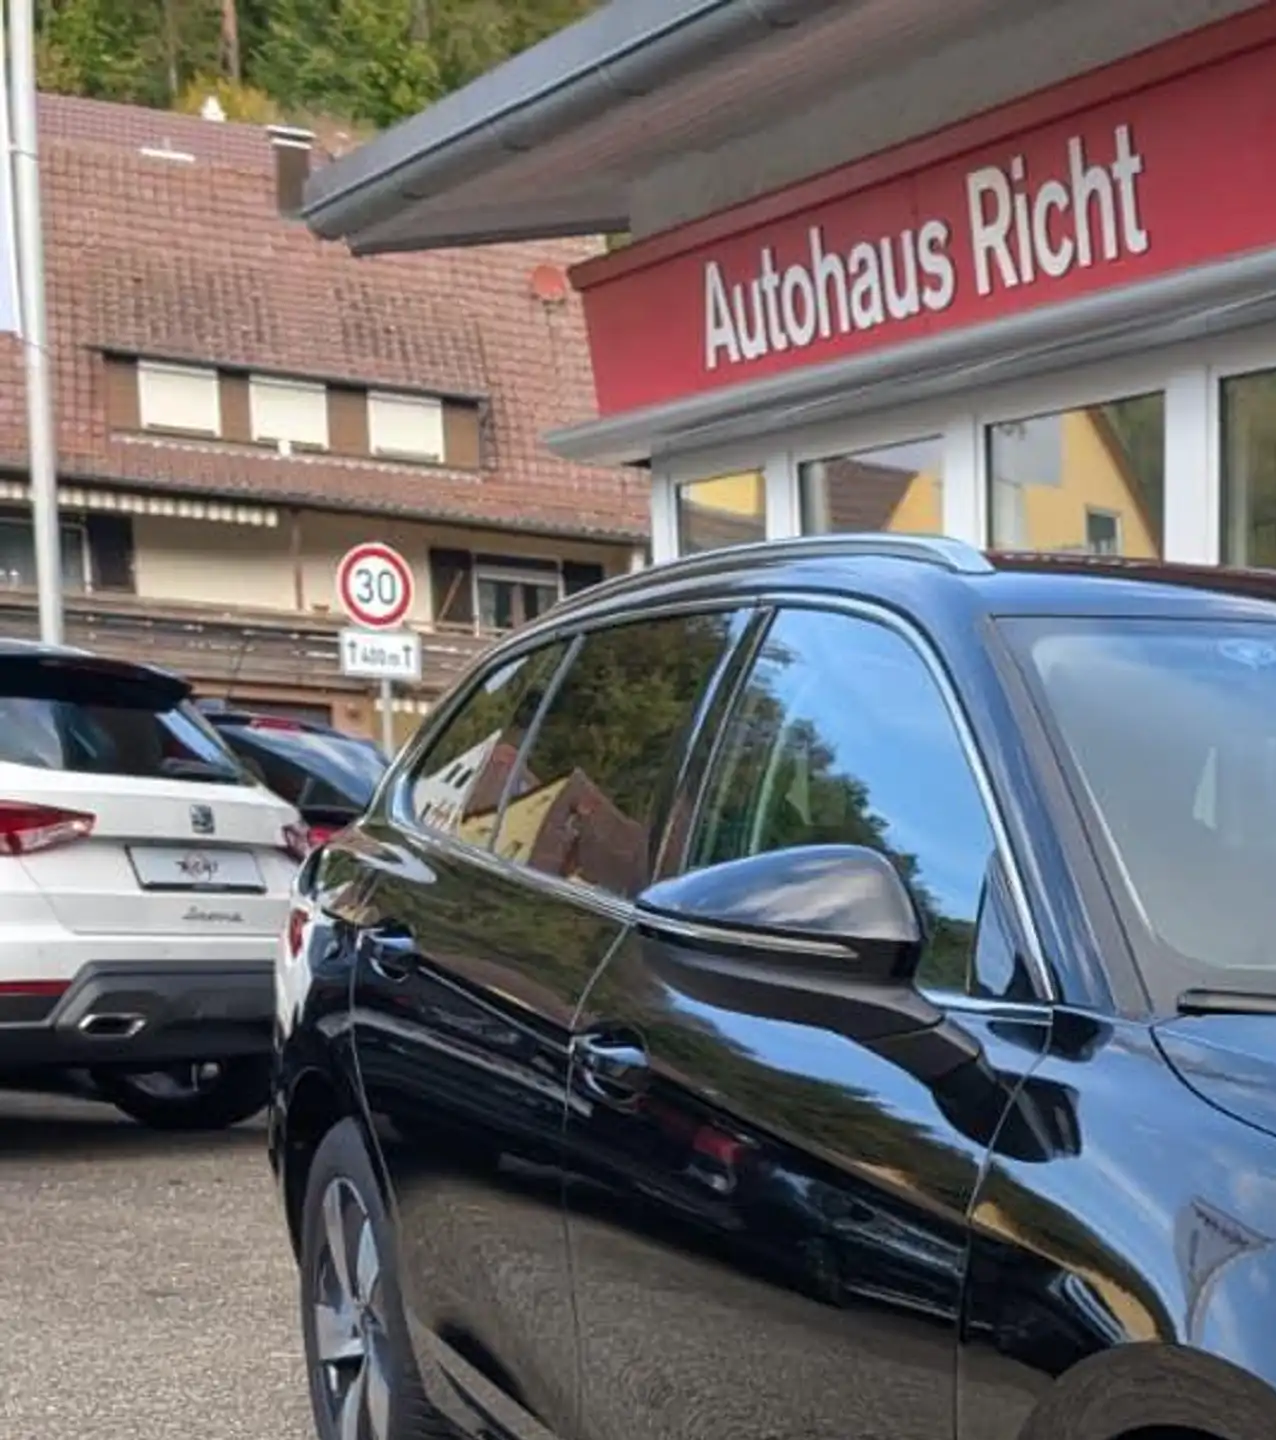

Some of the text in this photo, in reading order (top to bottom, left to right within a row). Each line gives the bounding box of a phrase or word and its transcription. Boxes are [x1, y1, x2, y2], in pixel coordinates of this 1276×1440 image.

[704, 123, 1149, 370] Autohaus Richt
[356, 568, 396, 605] 30
